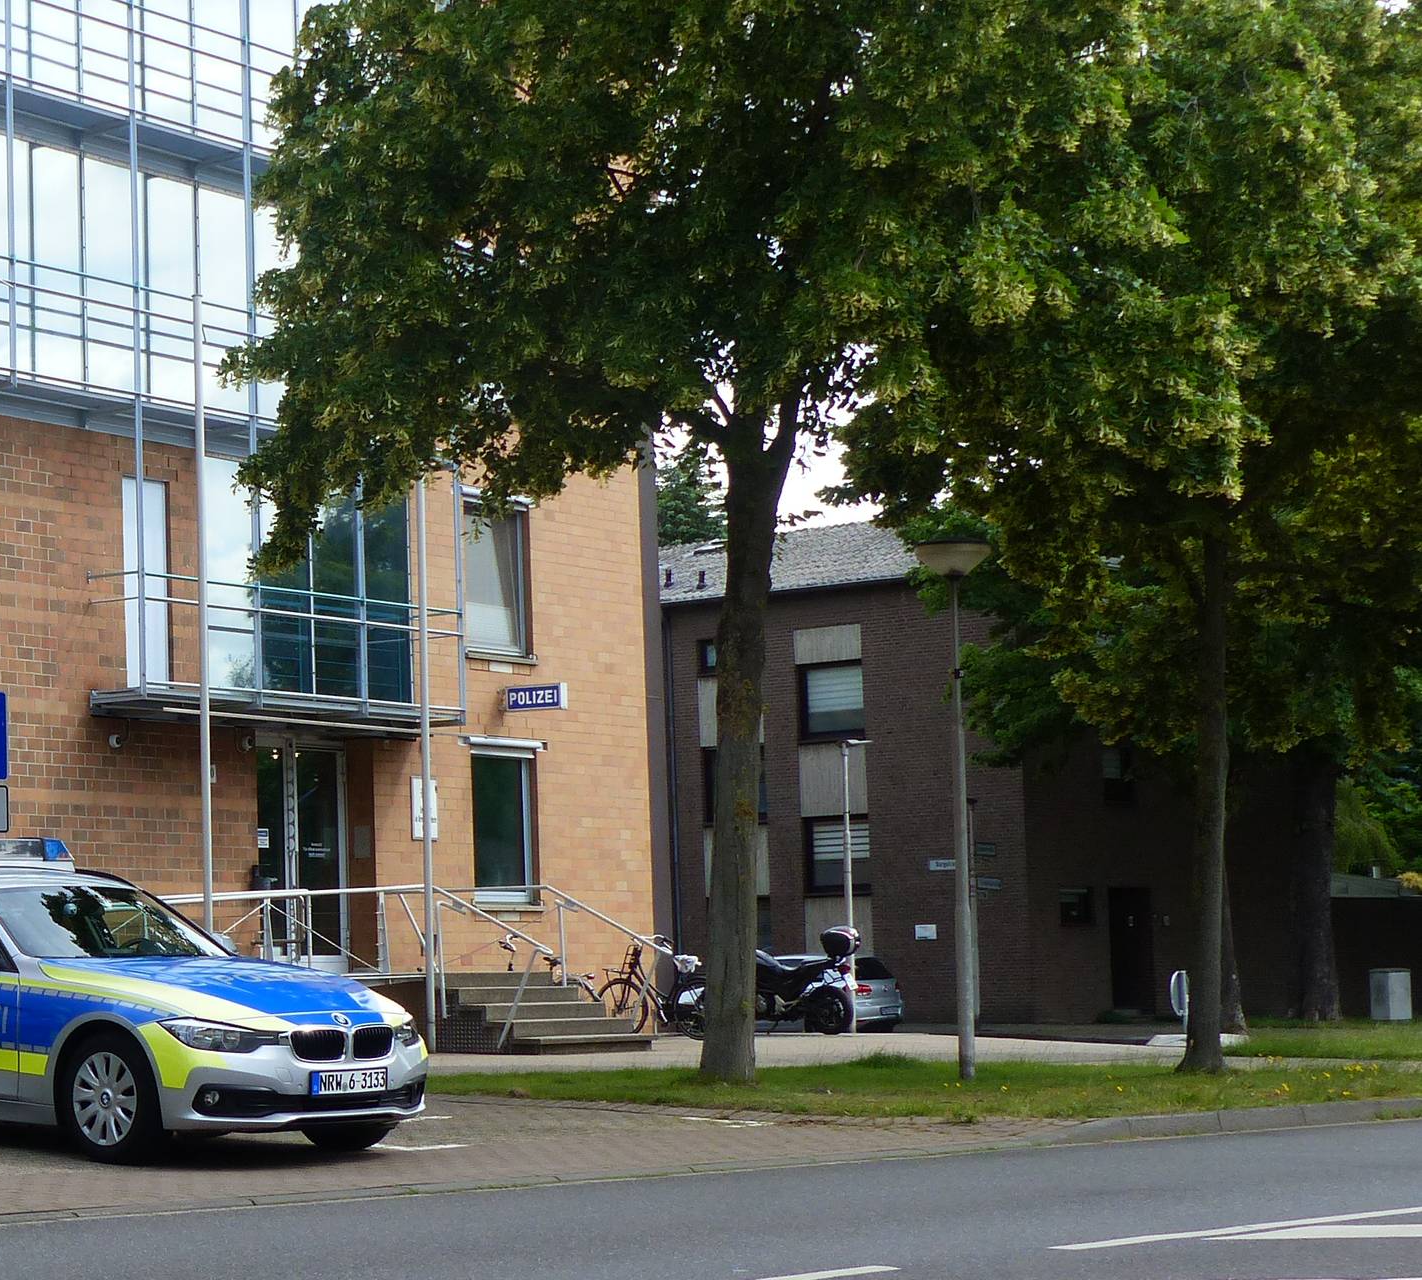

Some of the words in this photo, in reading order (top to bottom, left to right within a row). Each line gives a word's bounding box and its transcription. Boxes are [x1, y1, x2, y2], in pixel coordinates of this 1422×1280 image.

[509, 689, 557, 705] POLIZEI
[319, 1074, 342, 1092] NRW
[348, 1071, 386, 1090] 6-3133
